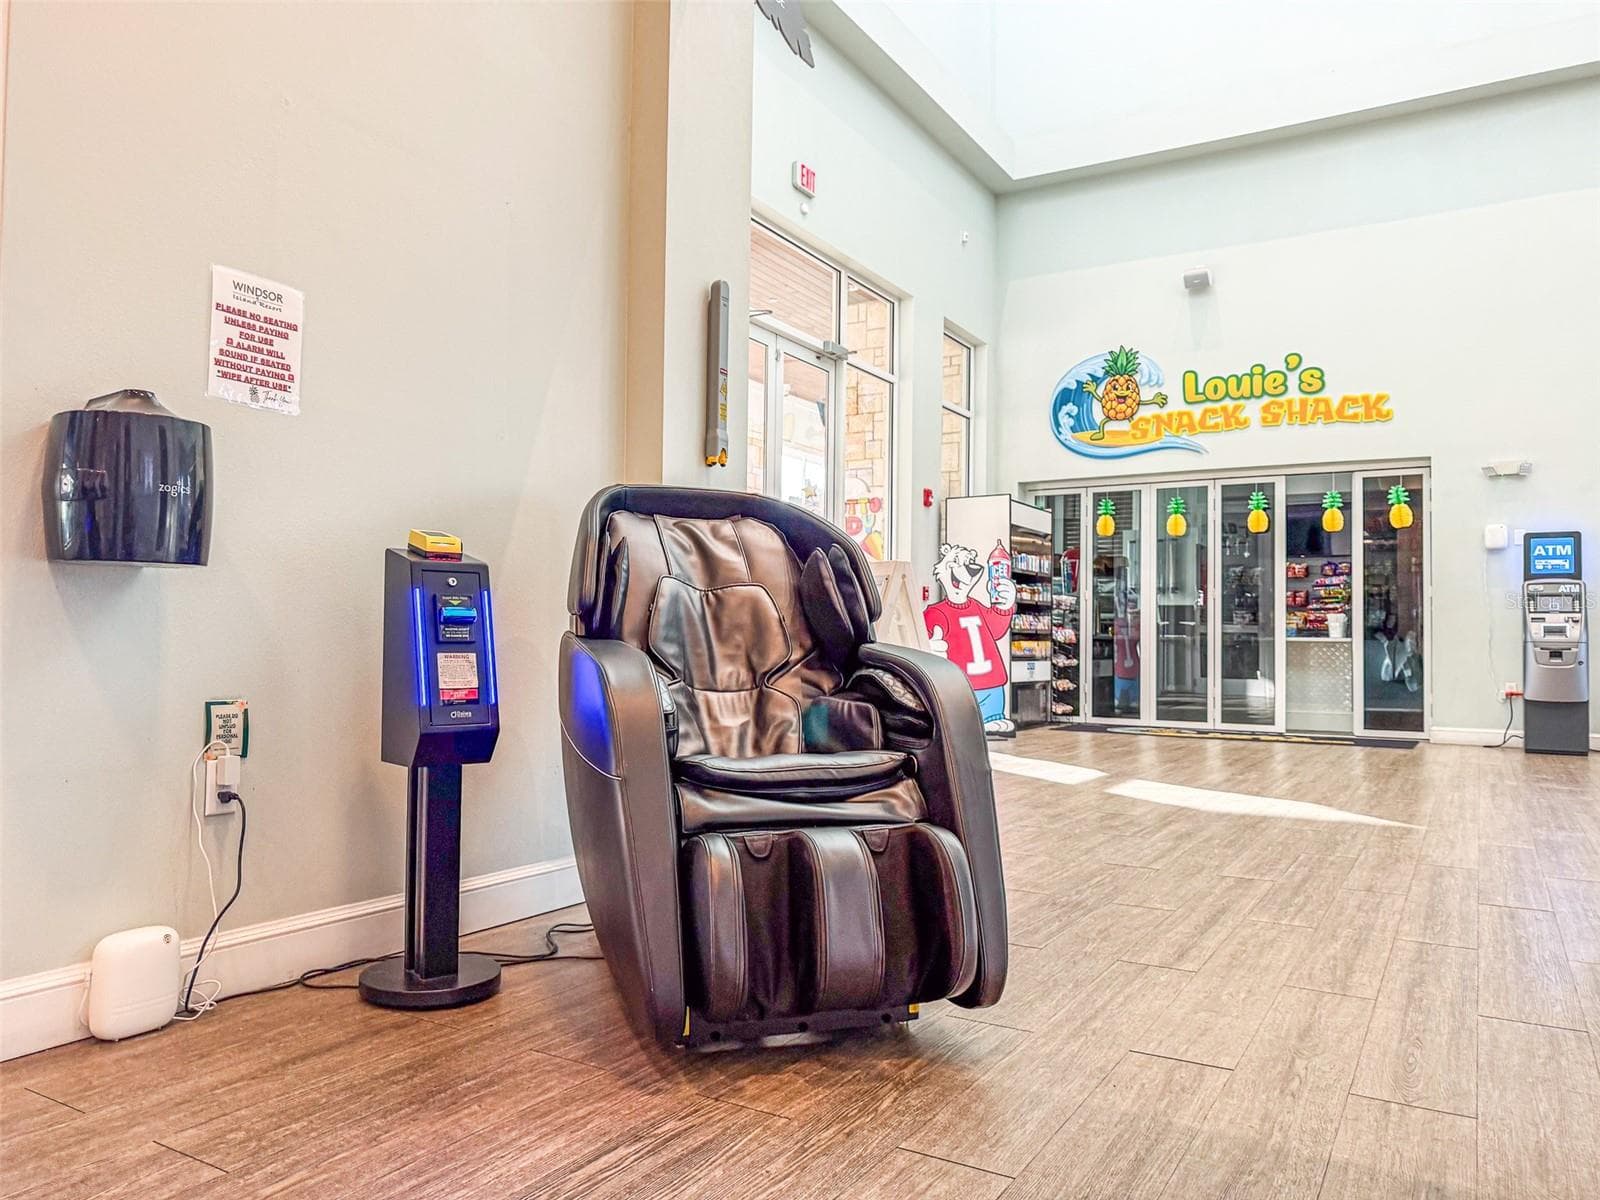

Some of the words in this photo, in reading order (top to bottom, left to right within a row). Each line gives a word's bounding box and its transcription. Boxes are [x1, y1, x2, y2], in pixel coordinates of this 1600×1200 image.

[801, 164, 816, 194] EXIT
[232, 279, 284, 304] WINDSOR
[215, 302, 248, 317] PLEASE
[249, 311, 262, 322] NO
[263, 316, 298, 332] SEATING
[224, 315, 257, 331] UNLESS
[258, 325, 289, 340] PAYING
[236, 341, 264, 355] ALARM
[266, 349, 286, 360] WILL
[239, 331, 256, 341] FOR
[257, 336, 274, 346] USE
[214, 357, 254, 373] WITHOUT
[255, 367, 286, 381] PAYING
[218, 348, 248, 362] SOUND
[250, 355, 259, 364] IF
[260, 358, 292, 372] SEATED
[244, 376, 270, 388] AFTER
[1183, 352, 1326, 404] Louie's
[1128, 403, 1250, 440] SNACK
[1260, 393, 1393, 427] SHACK
[158, 480, 191, 497] zogics
[1533, 544, 1572, 556] ATM
[1558, 584, 1580, 593] ATM
[958, 615, 993, 676] I
